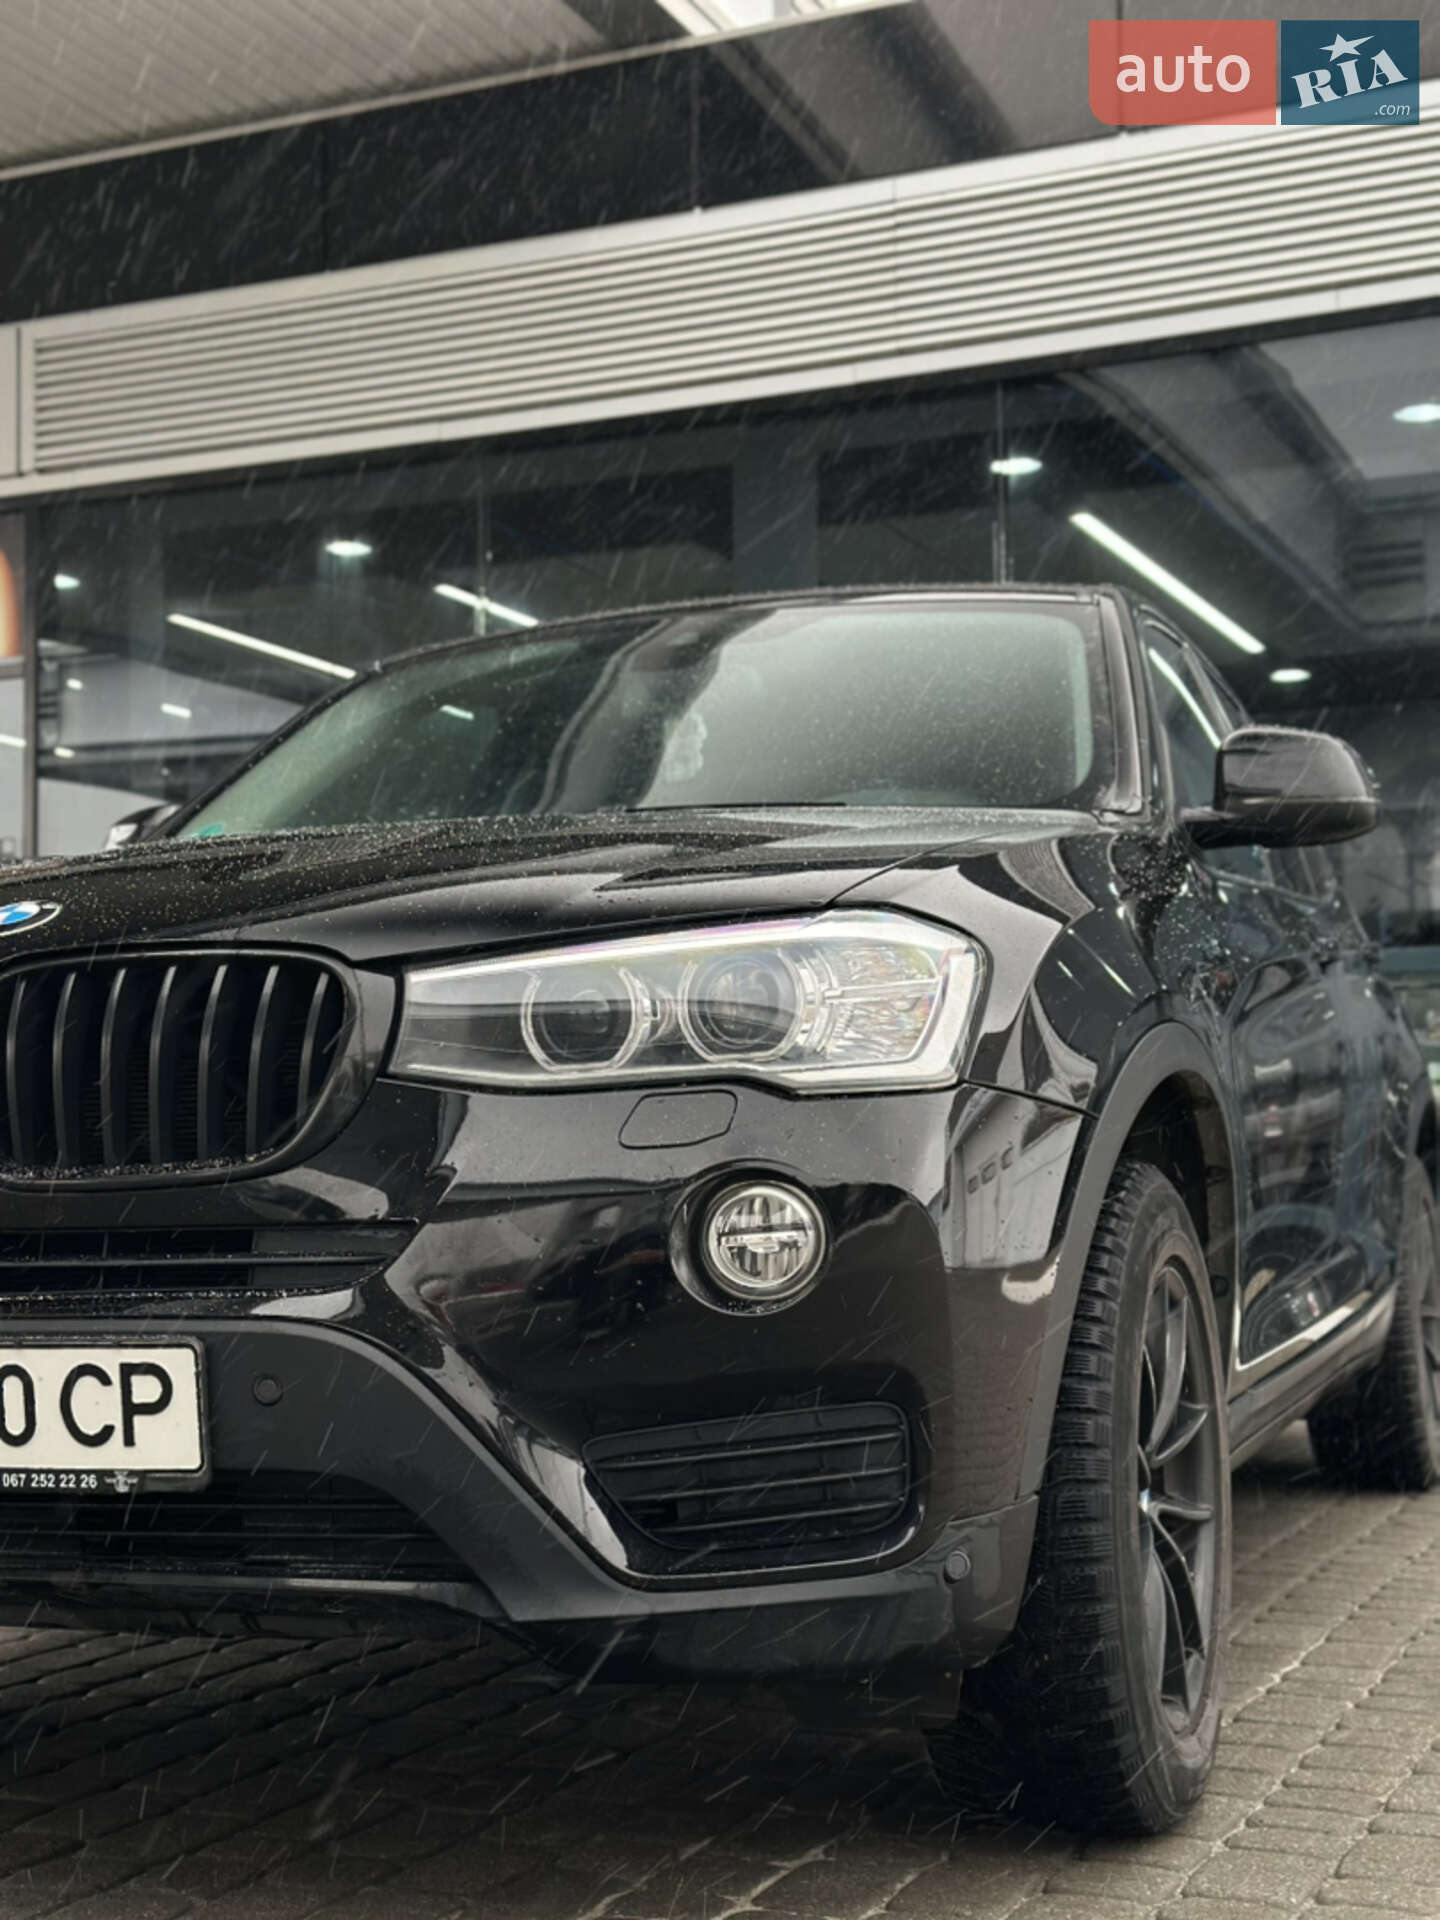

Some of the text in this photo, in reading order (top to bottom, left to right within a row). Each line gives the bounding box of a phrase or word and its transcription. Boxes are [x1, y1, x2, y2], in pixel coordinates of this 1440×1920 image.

[60, 1363, 173, 1447] CP
[2, 1473, 98, 1489] 067 252 22 26
